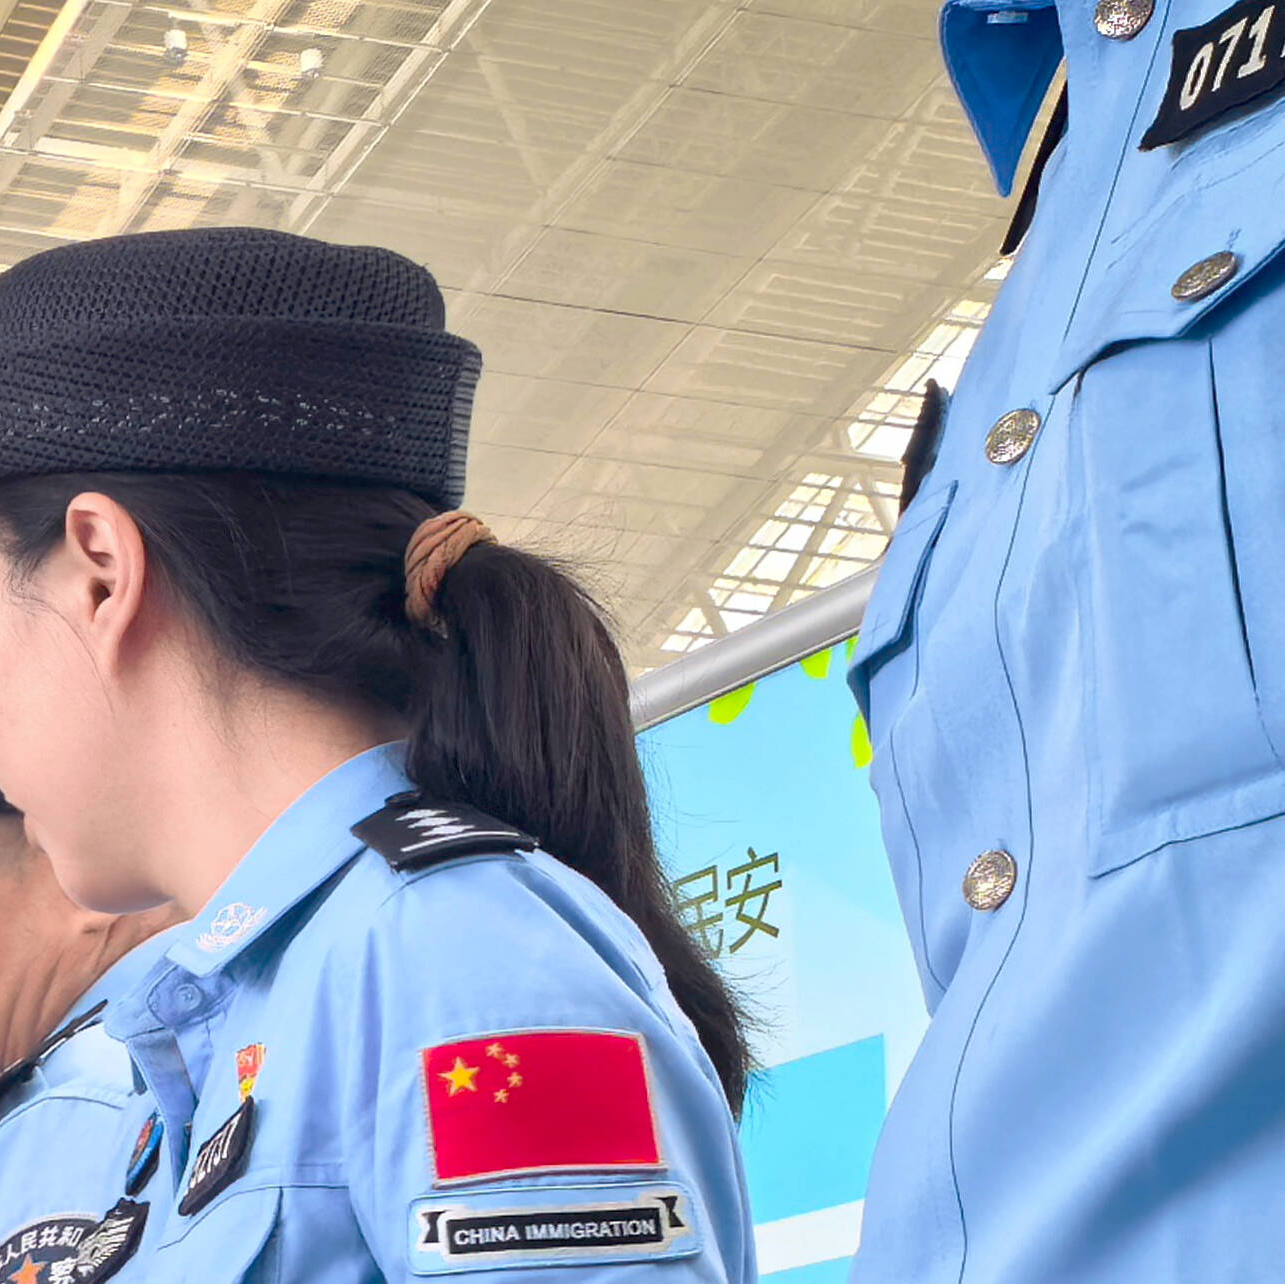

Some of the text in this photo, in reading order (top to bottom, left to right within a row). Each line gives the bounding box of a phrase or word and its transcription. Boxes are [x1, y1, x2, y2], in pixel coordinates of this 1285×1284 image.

[1179, 4, 1285, 111] 071
[454, 1219, 657, 1246] CHINA IMMIGRATION
